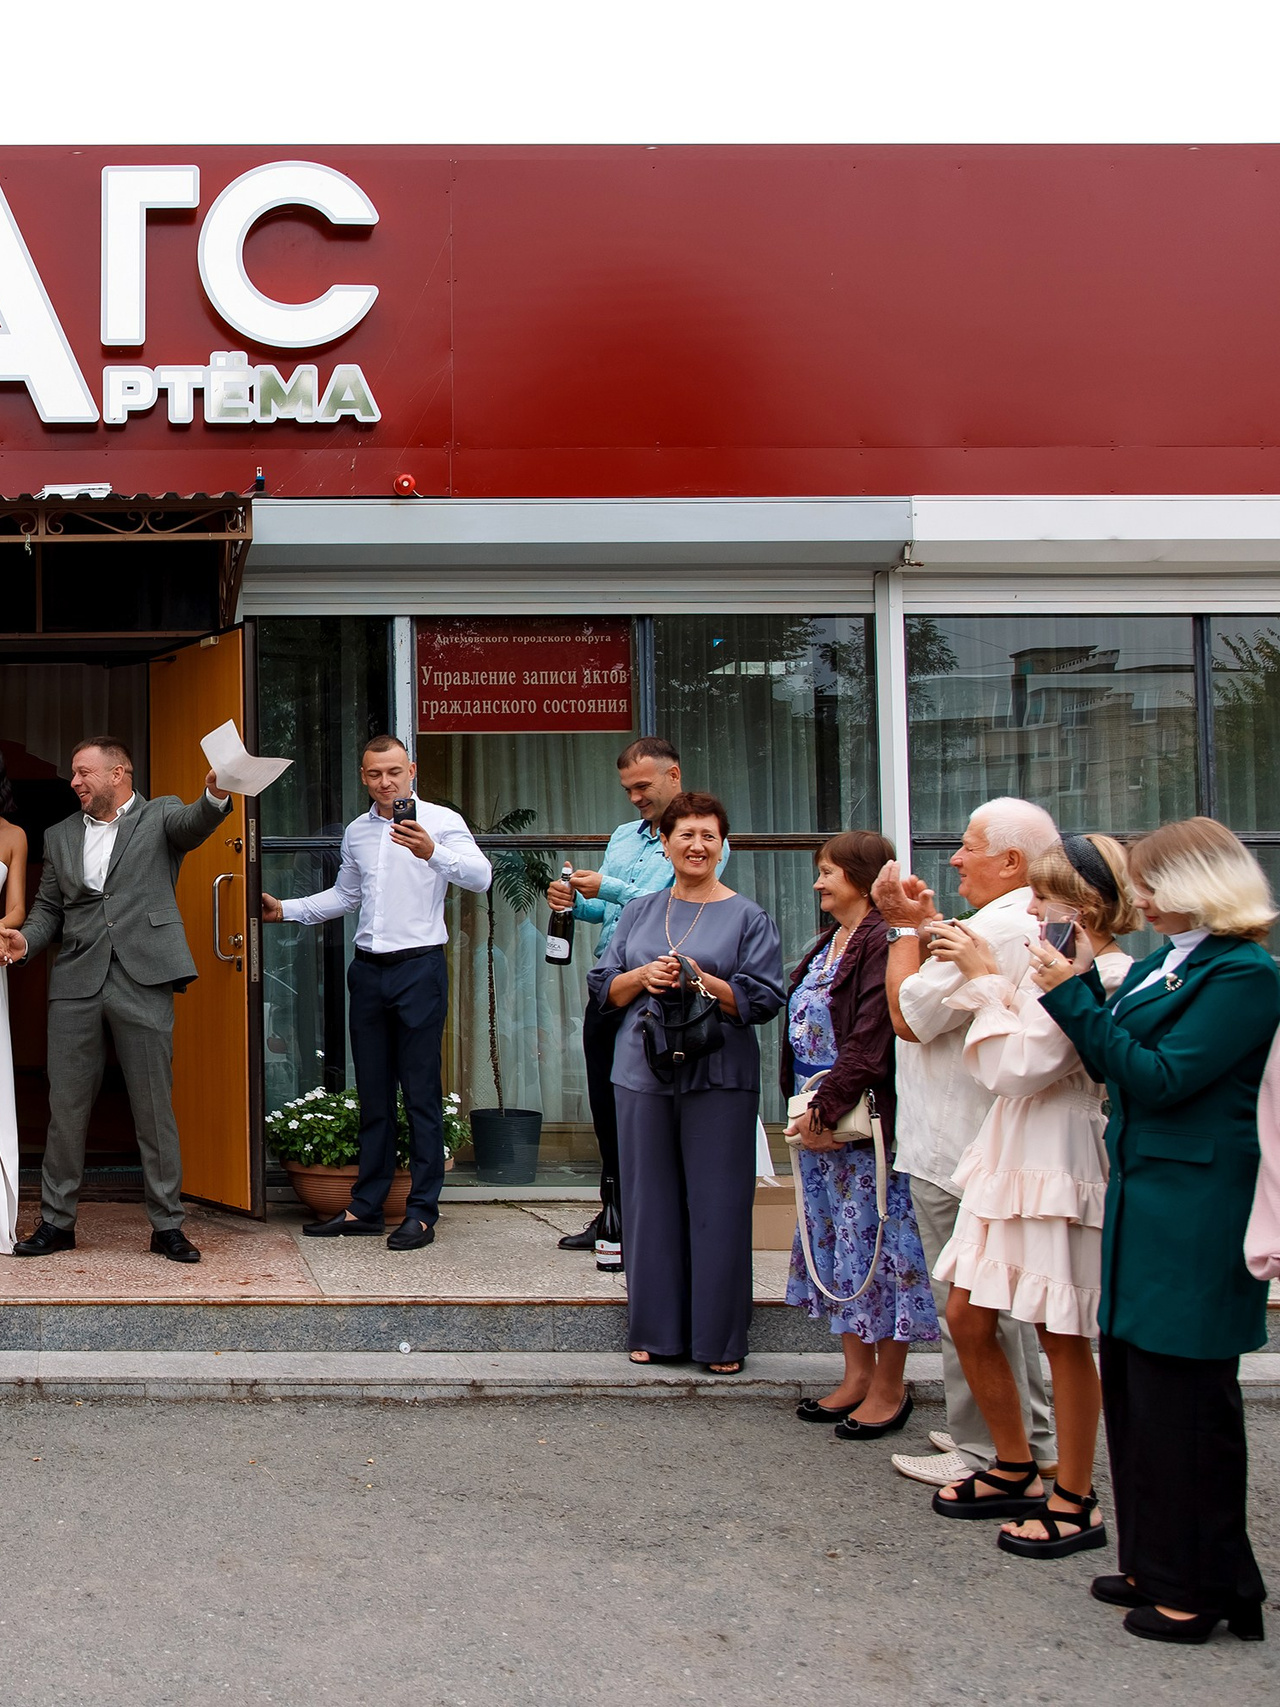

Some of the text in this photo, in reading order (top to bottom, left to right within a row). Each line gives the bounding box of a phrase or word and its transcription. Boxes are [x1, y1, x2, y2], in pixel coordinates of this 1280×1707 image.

[512, 634, 572, 644] городского
[575, 634, 611, 644] округа
[421, 666, 628, 691] Управление записи актов
[422, 698, 629, 719] гражданского состояния
